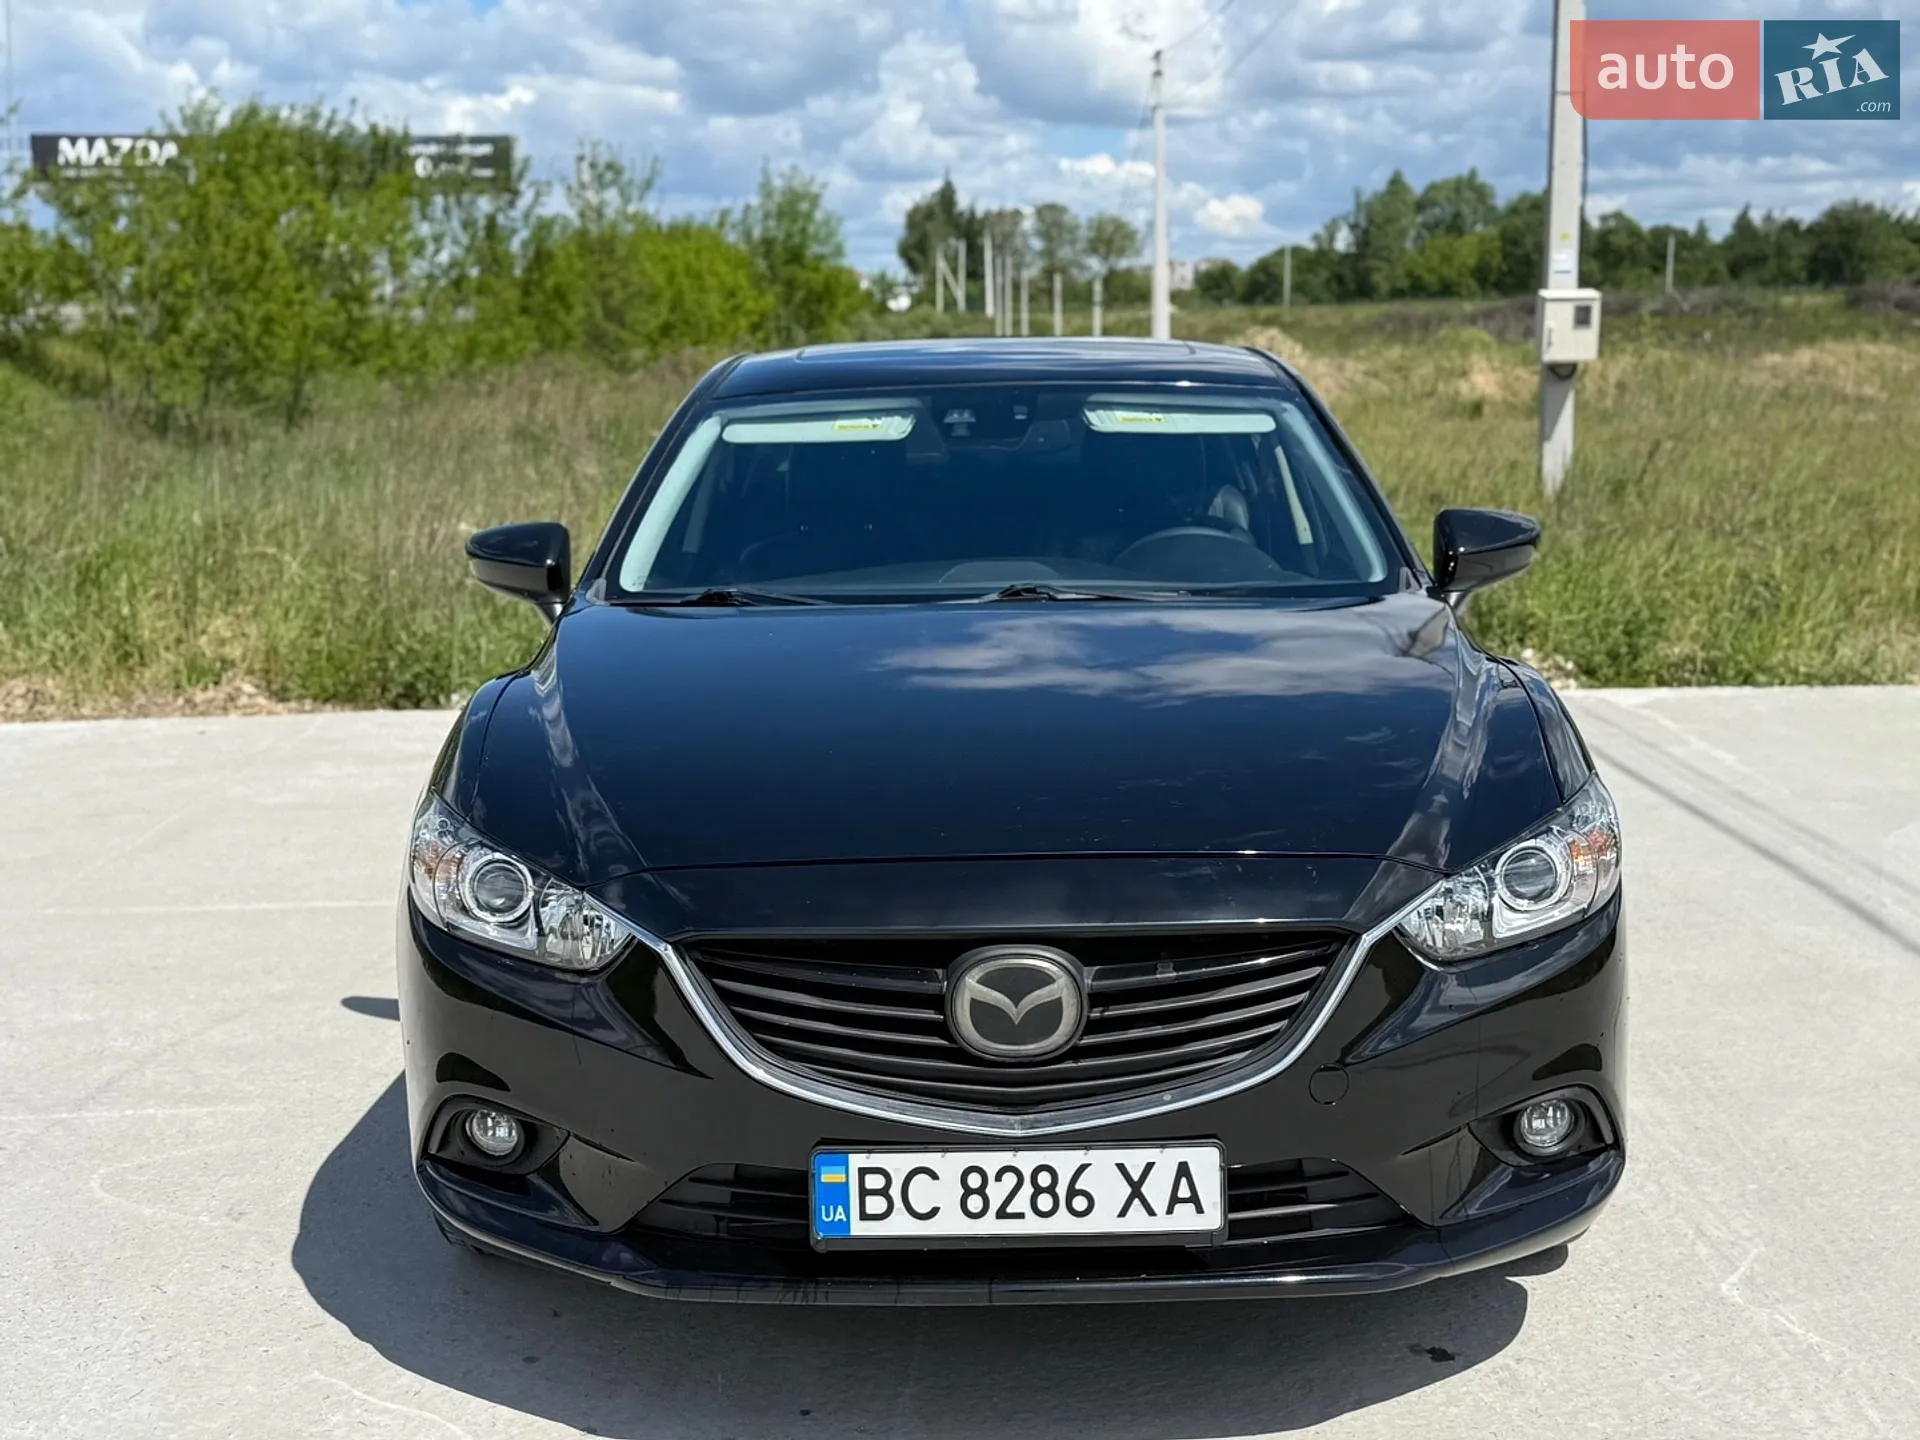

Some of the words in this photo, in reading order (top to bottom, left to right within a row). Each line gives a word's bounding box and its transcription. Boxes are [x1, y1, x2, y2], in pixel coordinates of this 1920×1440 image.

[857, 1166, 940, 1221] BC
[959, 1164, 1096, 1219] 8286
[1114, 1161, 1205, 1217] XA
[821, 1205, 847, 1222] UA
